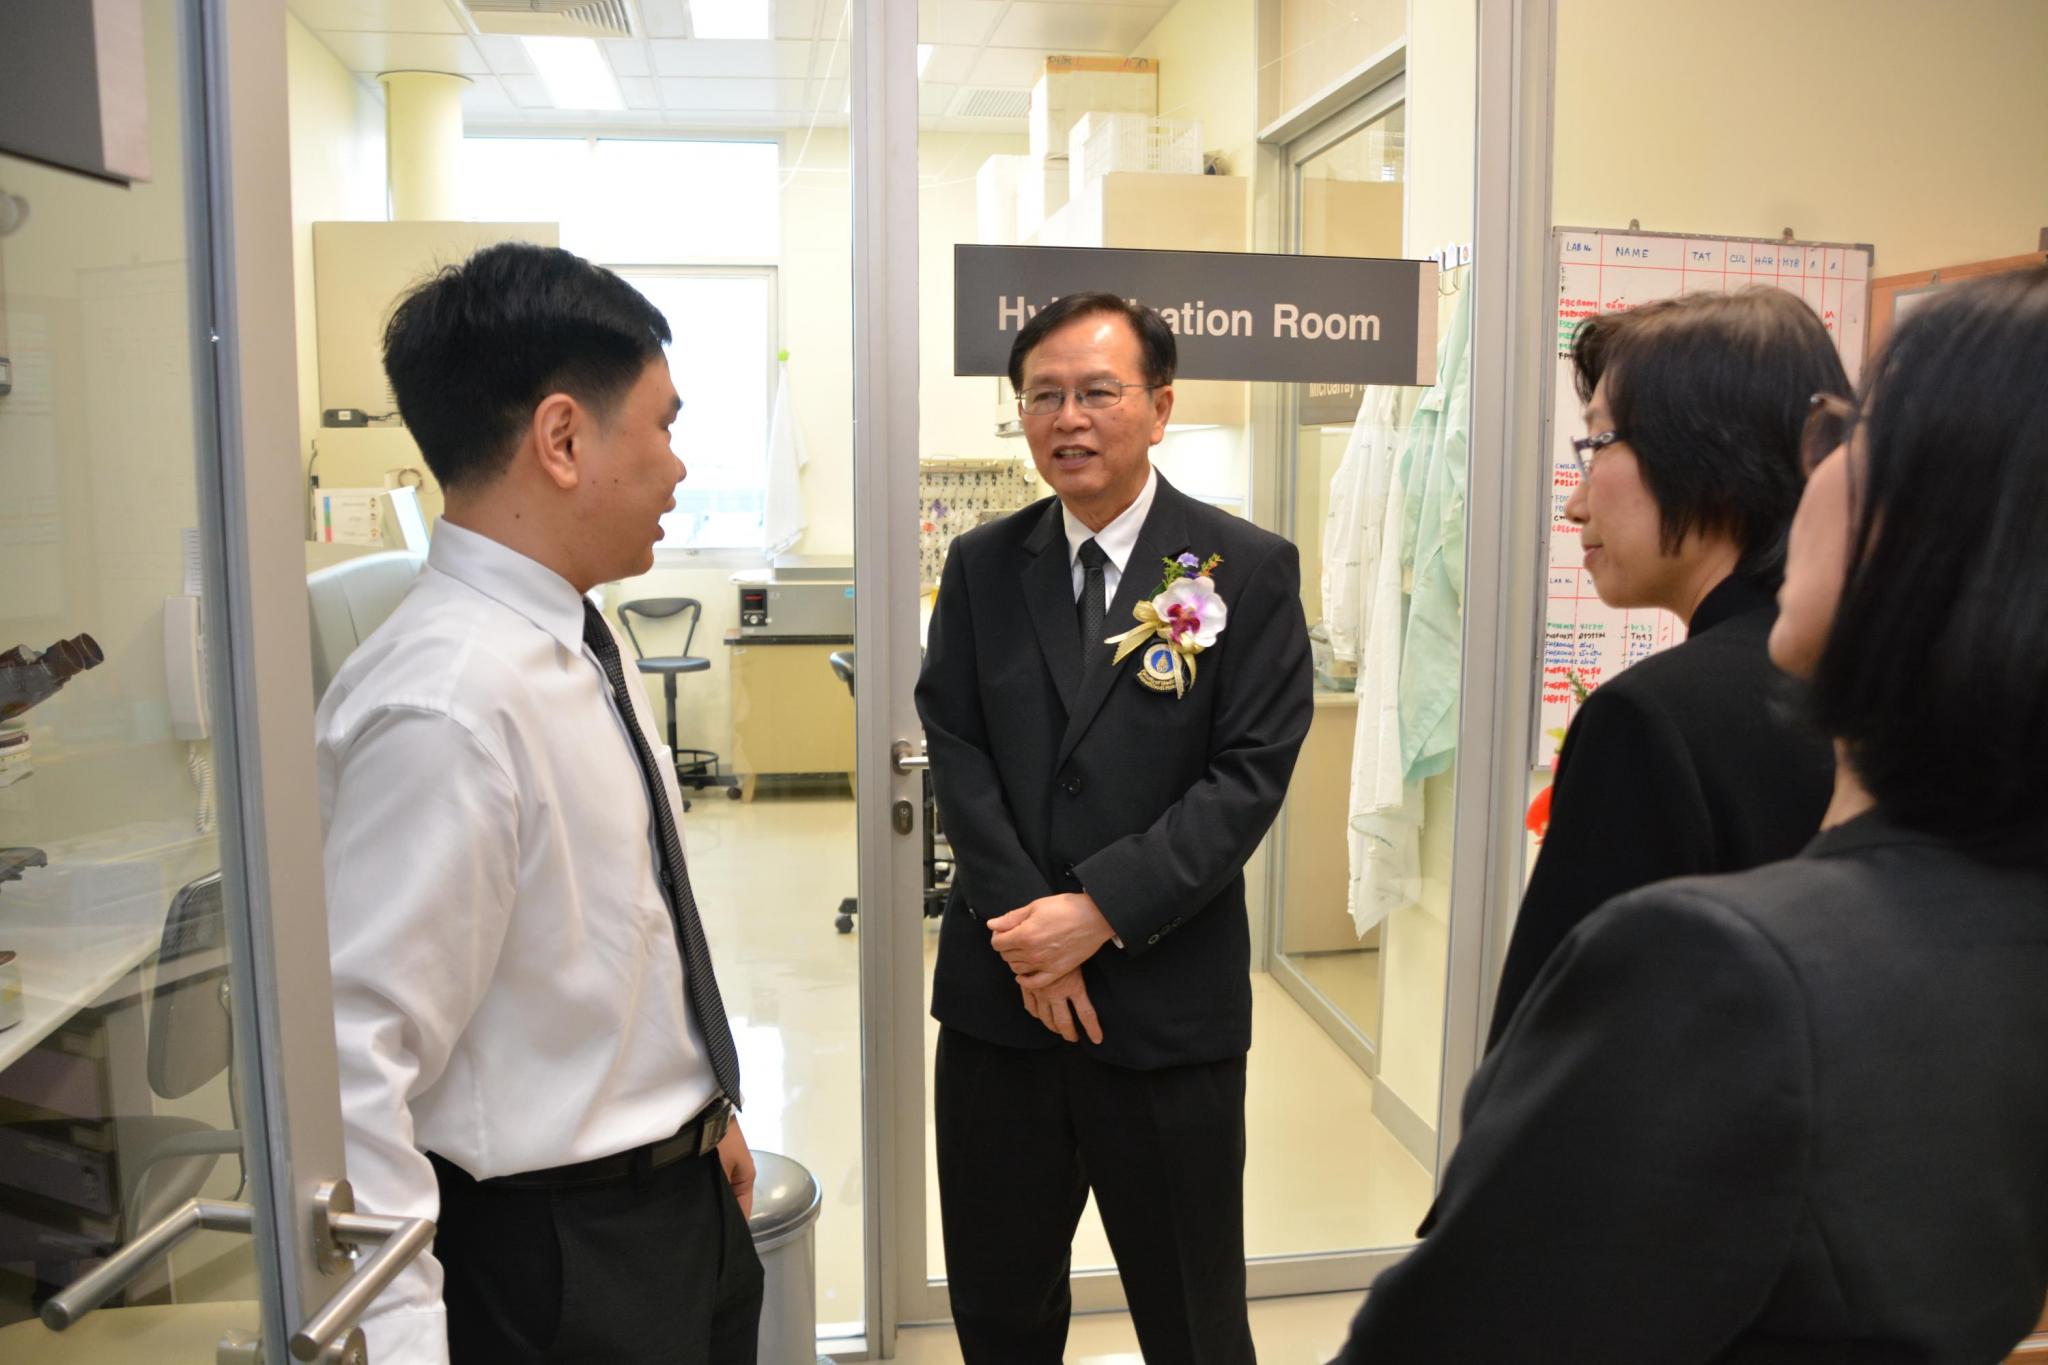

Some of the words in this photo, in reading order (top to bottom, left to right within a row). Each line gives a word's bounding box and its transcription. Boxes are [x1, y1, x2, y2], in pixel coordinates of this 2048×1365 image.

[1615, 246, 1649, 258] NAME
[1691, 251, 1712, 261] TAT
[1273, 303, 1380, 341] Room
